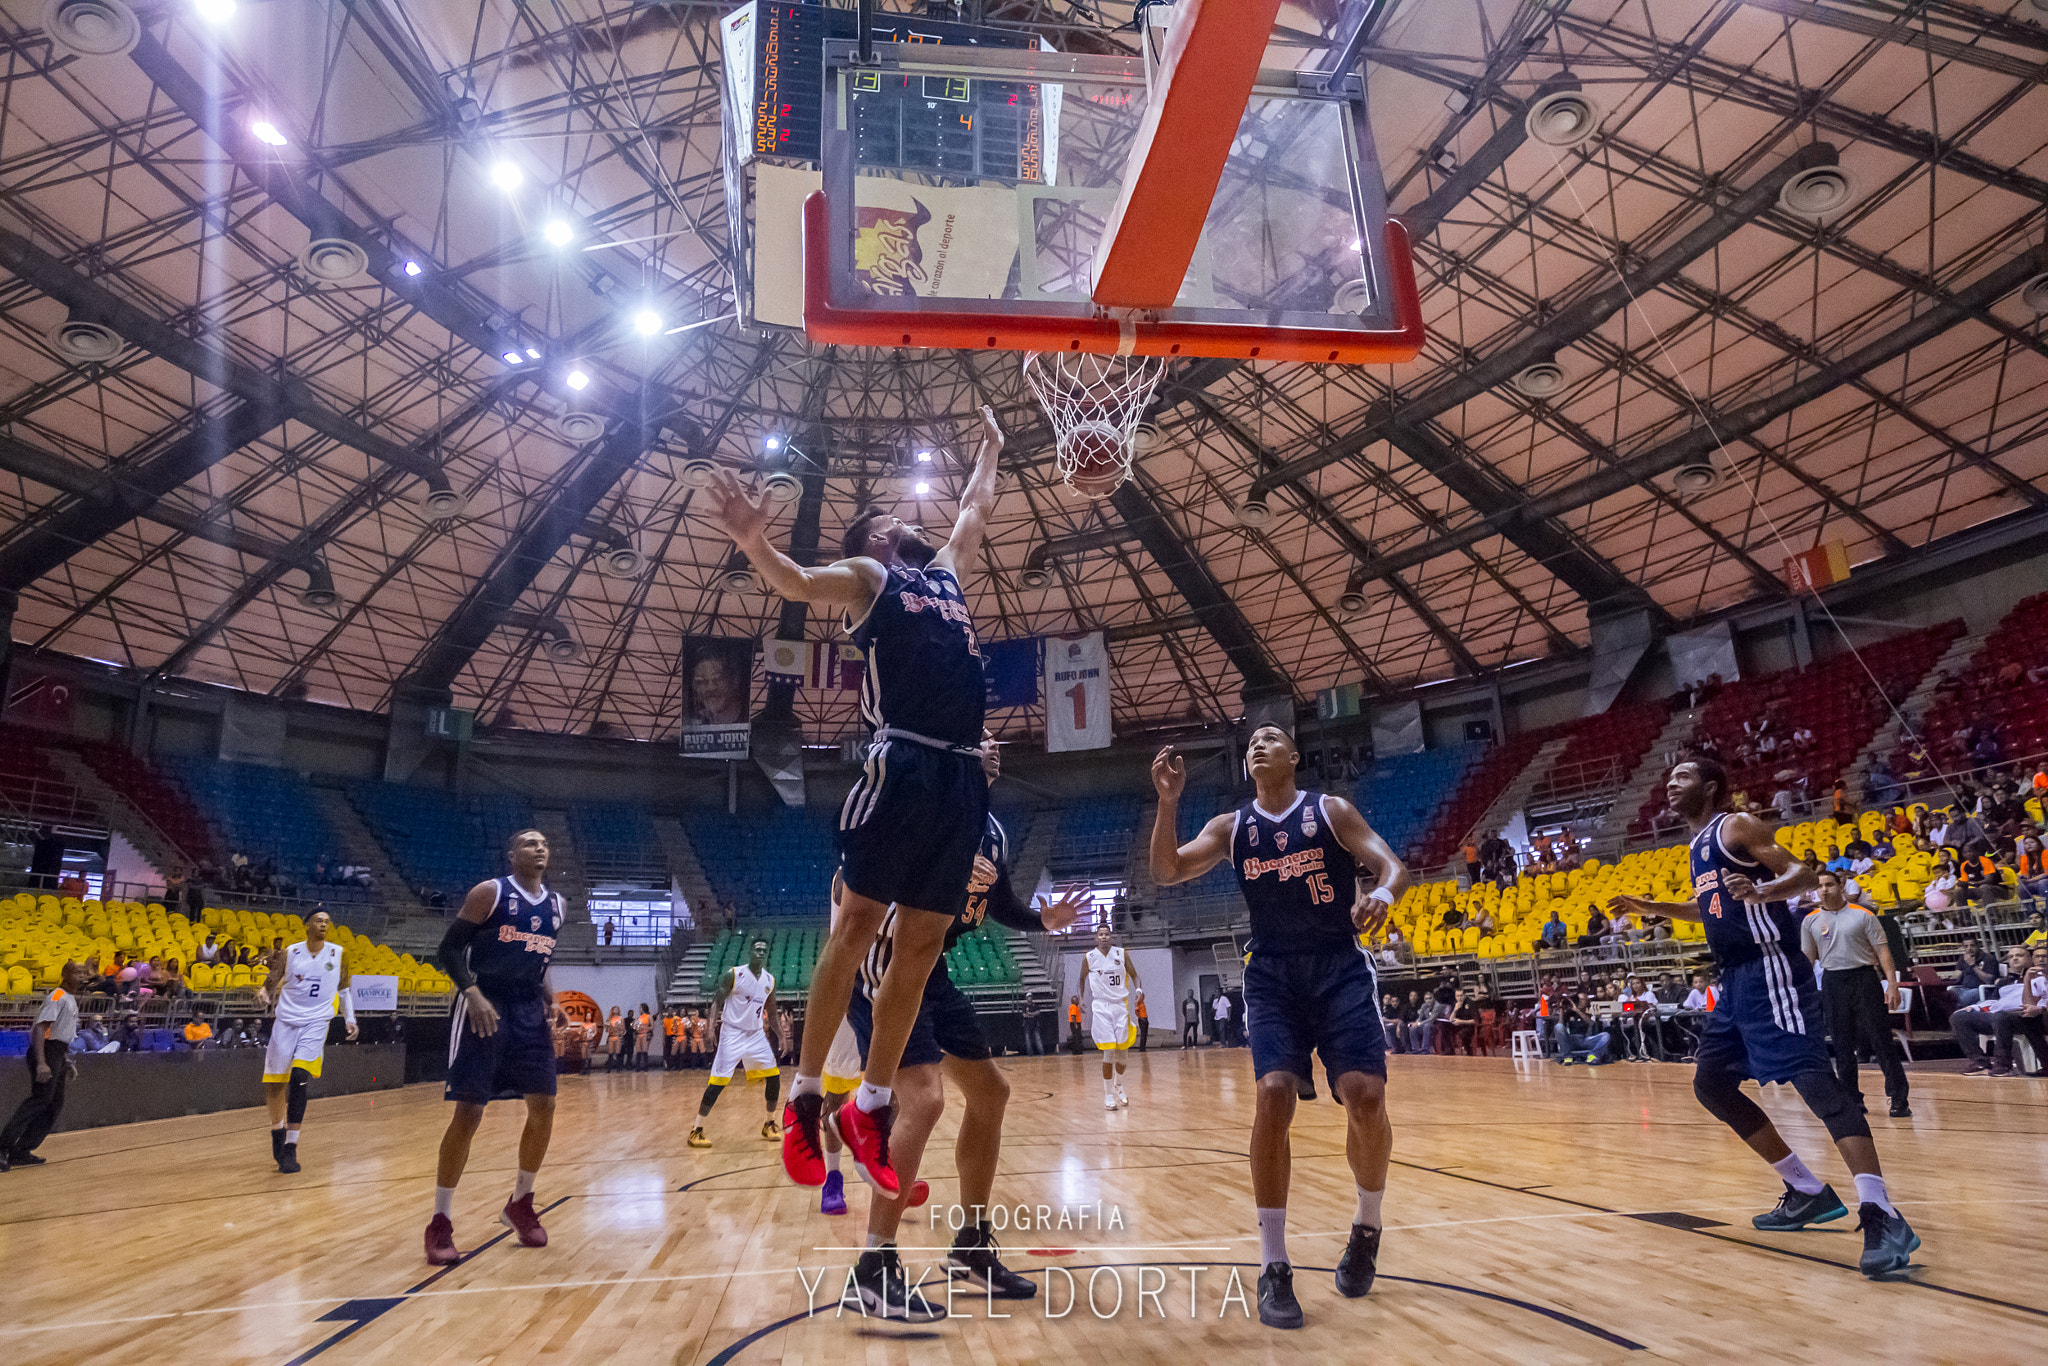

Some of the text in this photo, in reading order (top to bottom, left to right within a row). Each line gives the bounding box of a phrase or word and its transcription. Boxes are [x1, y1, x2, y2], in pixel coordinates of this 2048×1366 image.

[780, 104, 791, 117] 2
[959, 114, 972, 131] 4
[779, 129, 791, 142] 2
[941, 213, 956, 250] deporte
[1054, 668, 1100, 682] RUFO JOHN
[1065, 682, 1087, 730] 1
[683, 732, 748, 745] RUFO JOHN
[1244, 848, 1324, 880] Bucaneros
[1291, 860, 1325, 877] Guaira
[1306, 873, 1334, 904] 15
[961, 895, 988, 927] 54
[1709, 893, 1722, 918] 4
[1109, 975, 1121, 986] 30
[309, 983, 320, 998] 2
